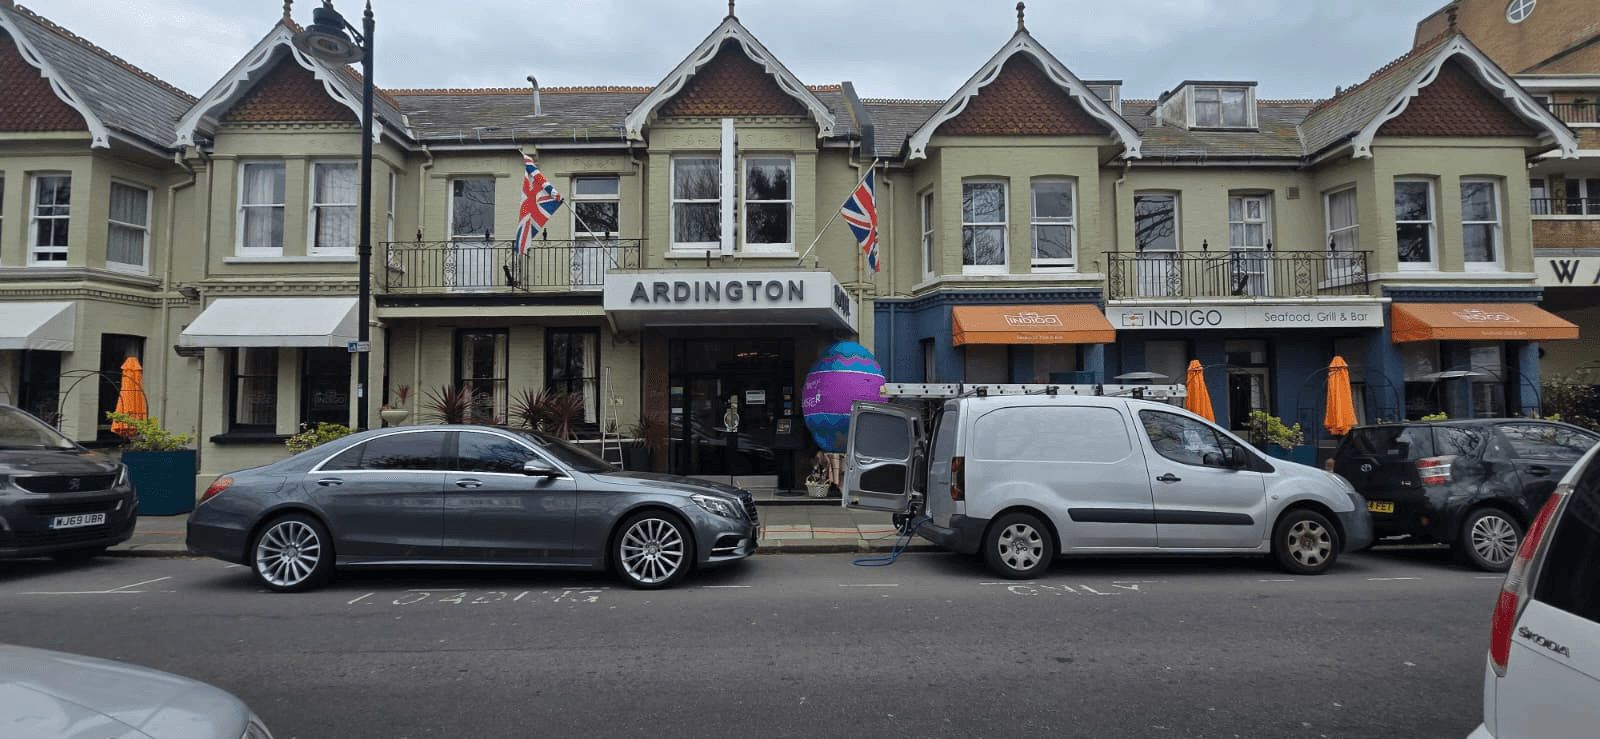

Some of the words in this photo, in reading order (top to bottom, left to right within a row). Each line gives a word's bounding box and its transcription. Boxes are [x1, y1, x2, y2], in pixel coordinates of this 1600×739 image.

[630, 280, 804, 303] ARDINGTON
[1149, 309, 1223, 326] INDIGO
[1264, 311, 1313, 323] Seafood,
[1316, 311, 1337, 322] Grill
[1340, 312, 1348, 322] &
[1351, 311, 1369, 321] Bar
